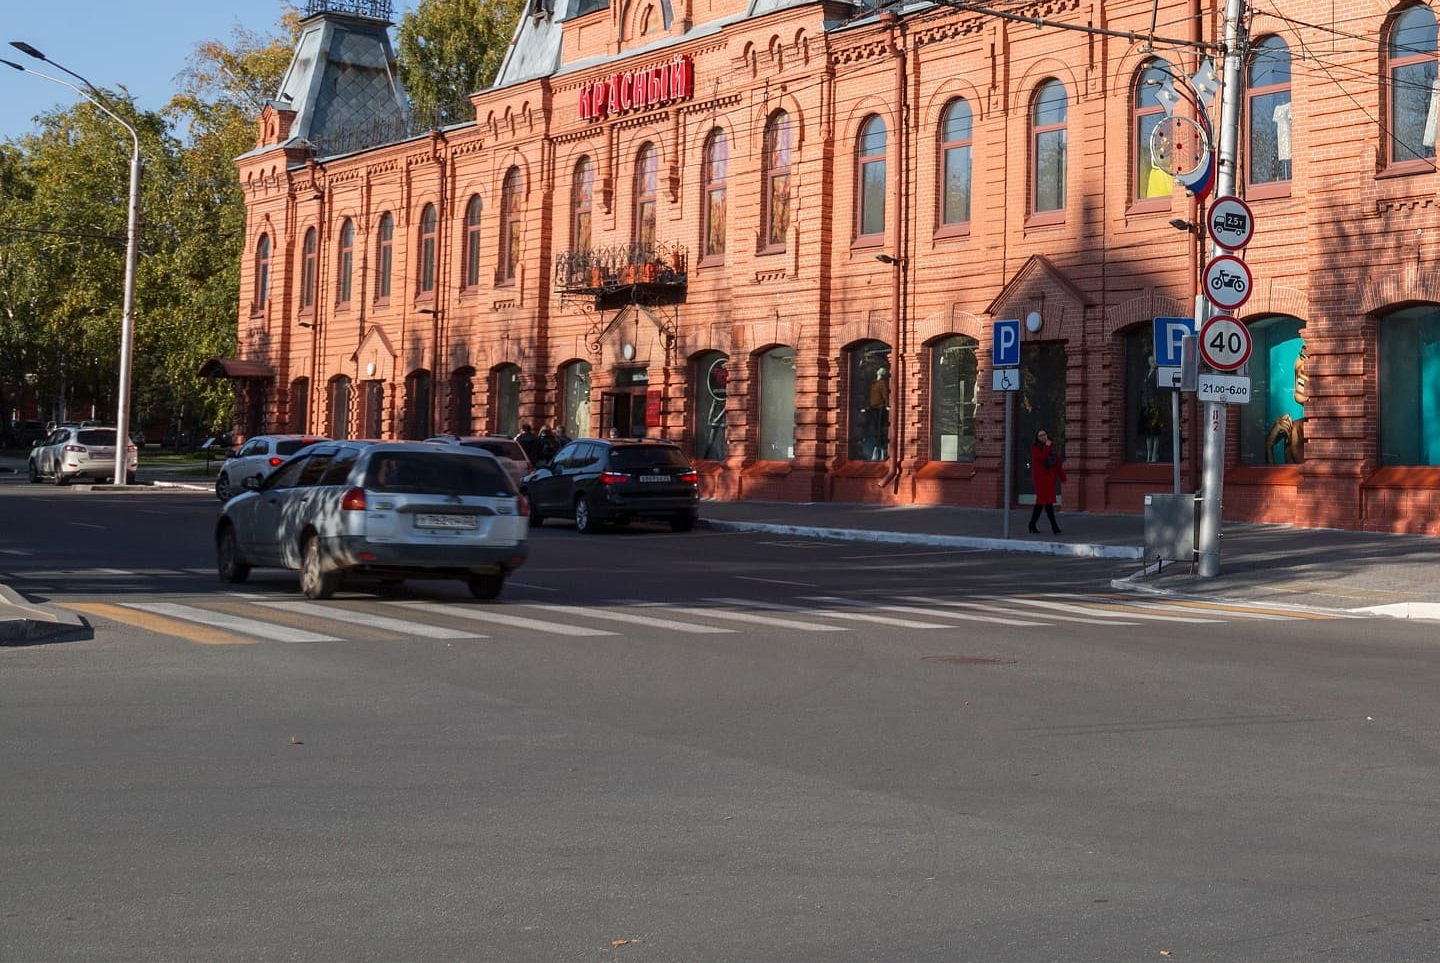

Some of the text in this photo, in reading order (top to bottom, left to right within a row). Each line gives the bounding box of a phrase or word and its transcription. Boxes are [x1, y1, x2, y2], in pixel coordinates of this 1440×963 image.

[576, 53, 688, 120] КРАСНЫЙ
[1000, 325, 1015, 361] P
[1209, 331, 1242, 354] 40
[1202, 383, 1248, 396] 21.00-6.00
